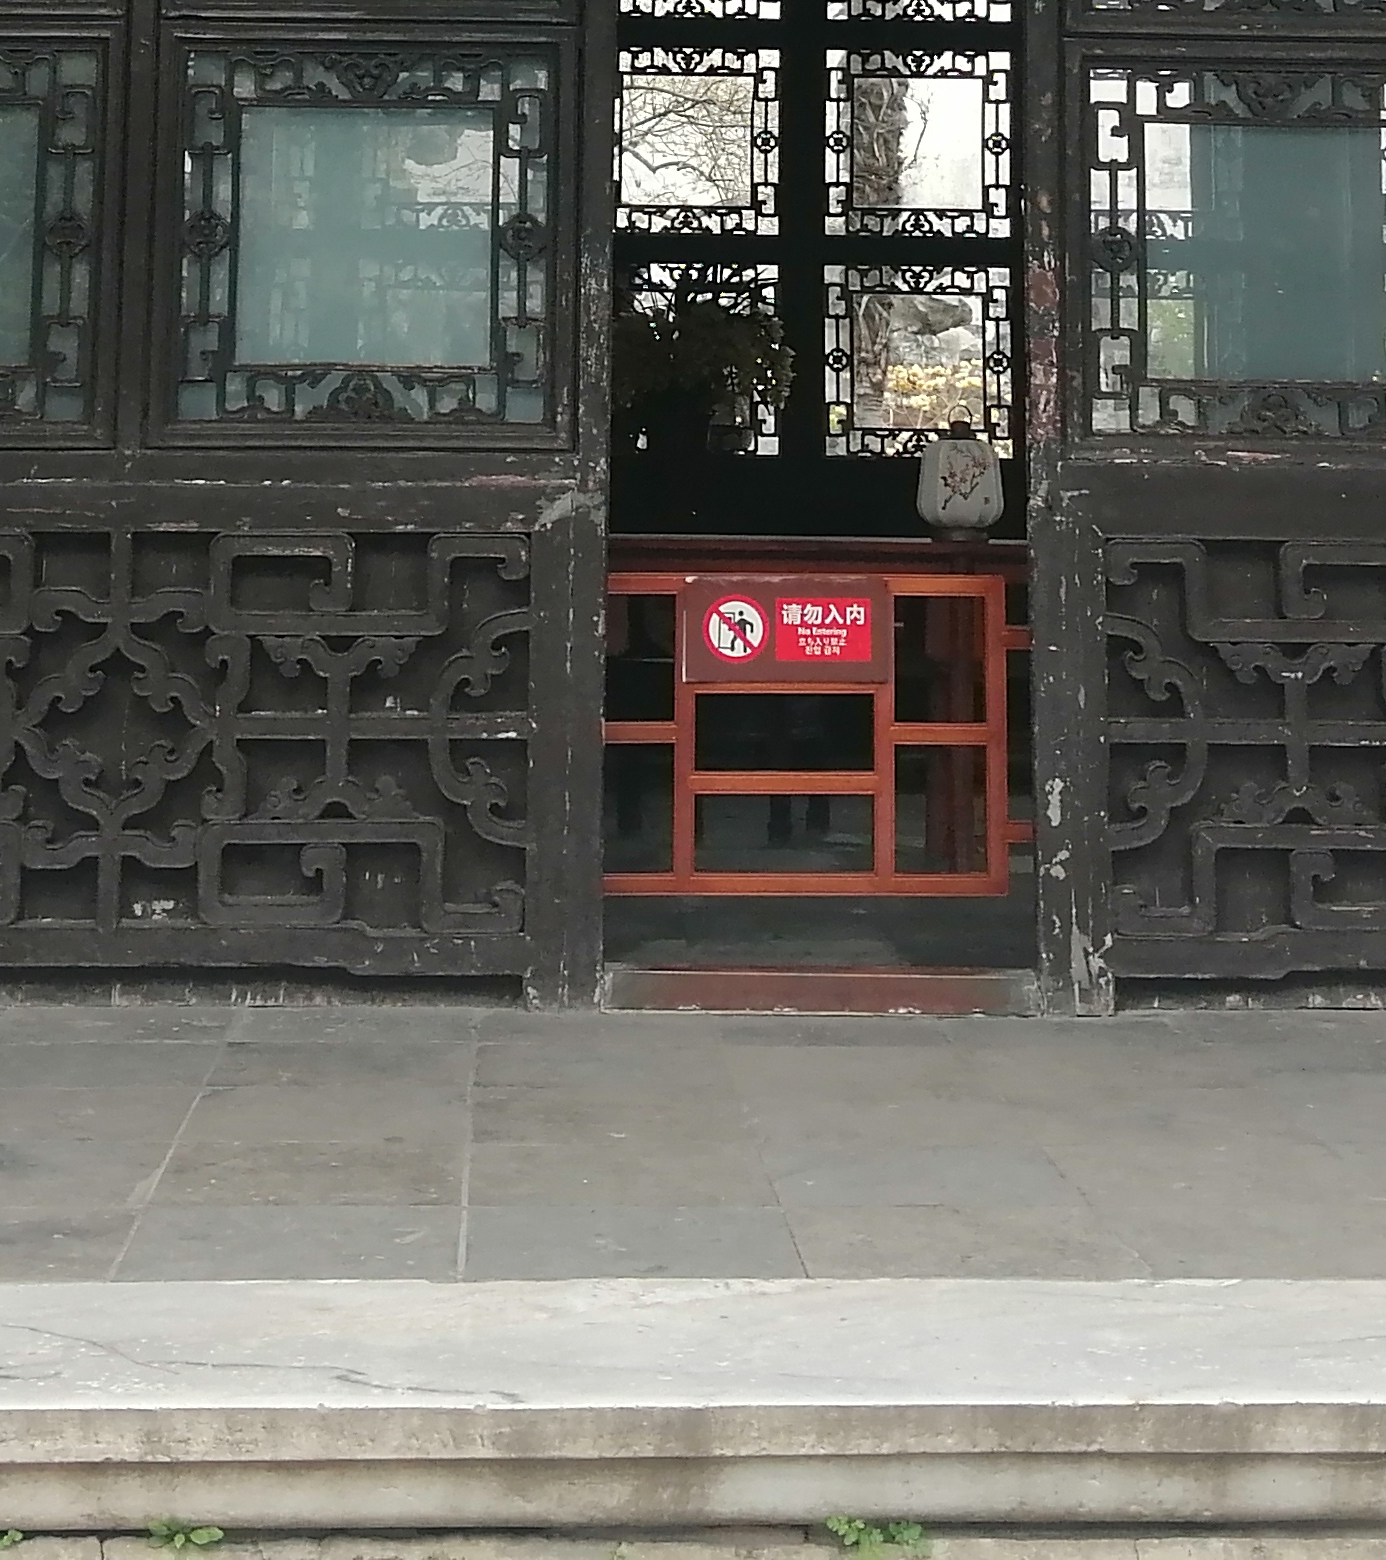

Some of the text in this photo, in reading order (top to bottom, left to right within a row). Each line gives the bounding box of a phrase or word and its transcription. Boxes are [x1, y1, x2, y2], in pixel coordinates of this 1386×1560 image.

[781, 603, 865, 625] 请勿入内
[797, 626, 847, 637] No Entering
